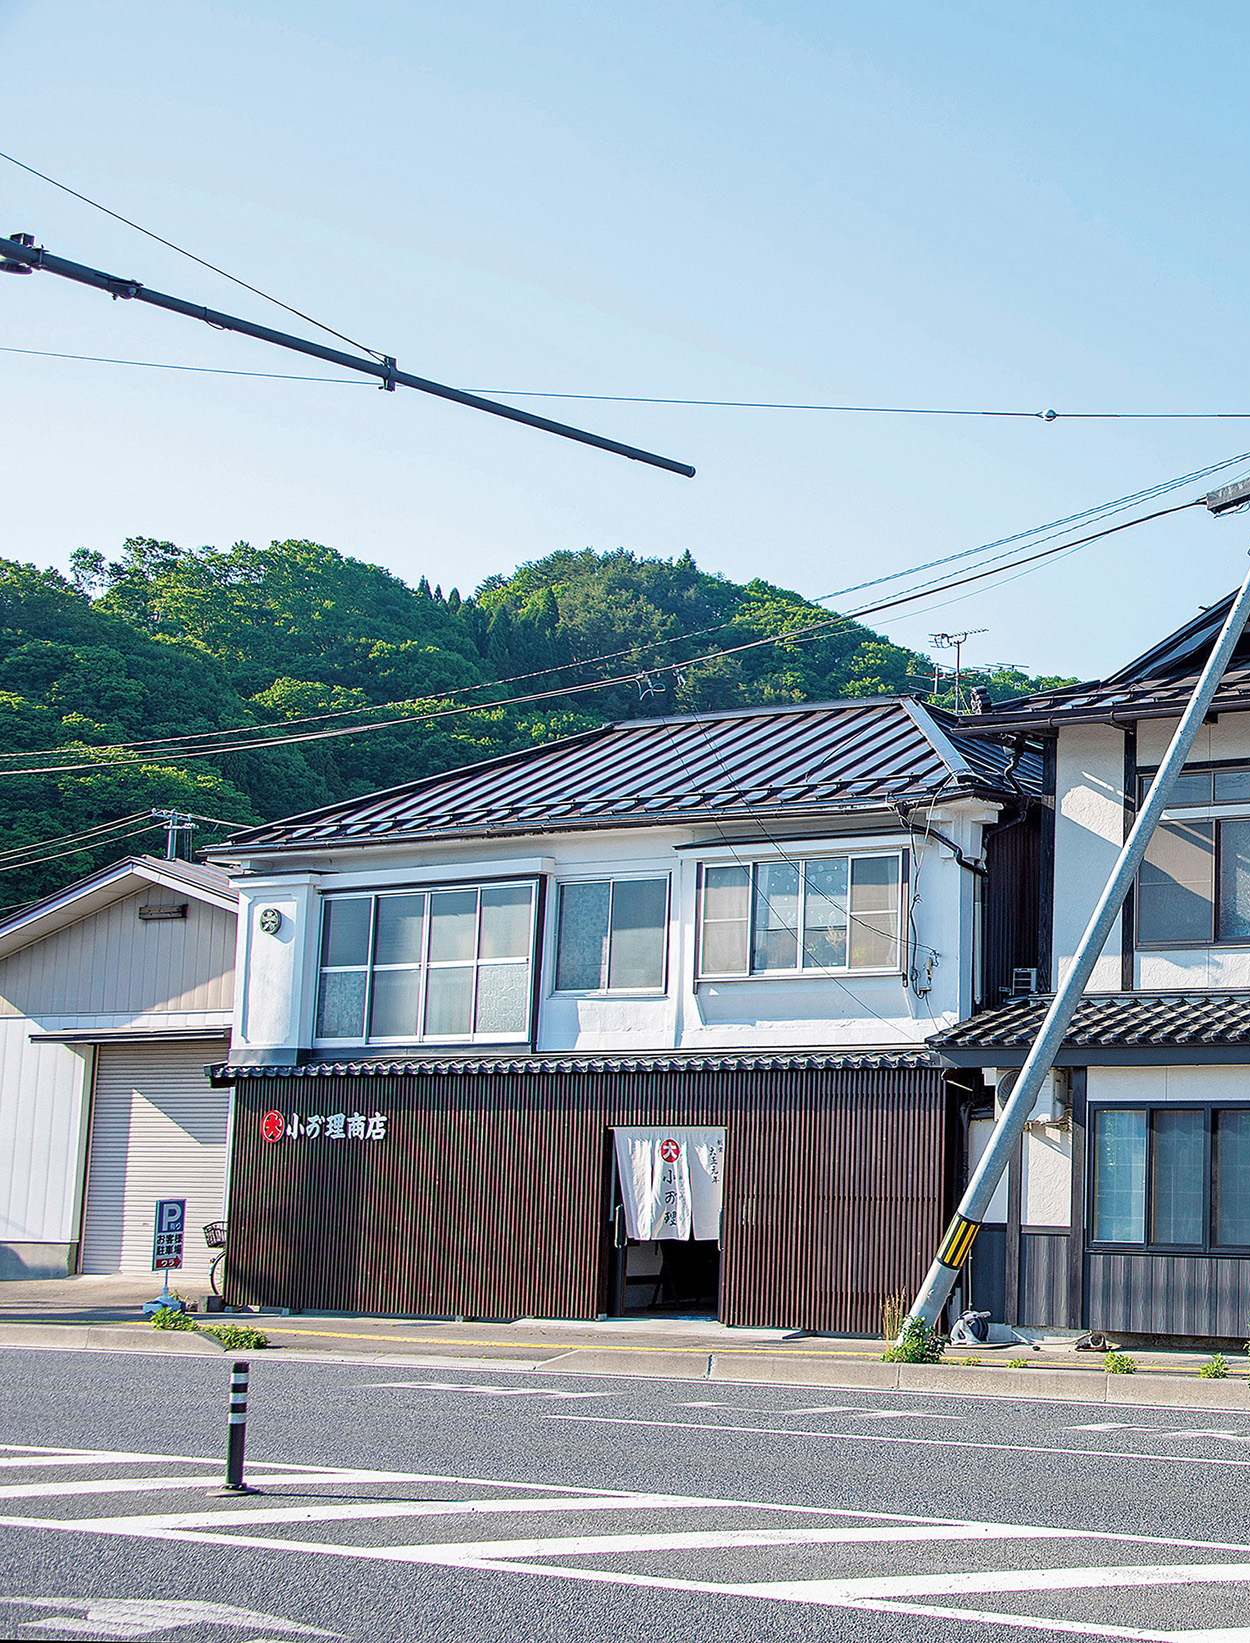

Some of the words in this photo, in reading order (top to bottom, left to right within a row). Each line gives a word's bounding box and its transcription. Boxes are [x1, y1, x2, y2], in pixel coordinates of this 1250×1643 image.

[162, 1203, 182, 1231] P
[157, 1233, 183, 1245] お客様
[156, 1245, 182, 1256] 駐車場
